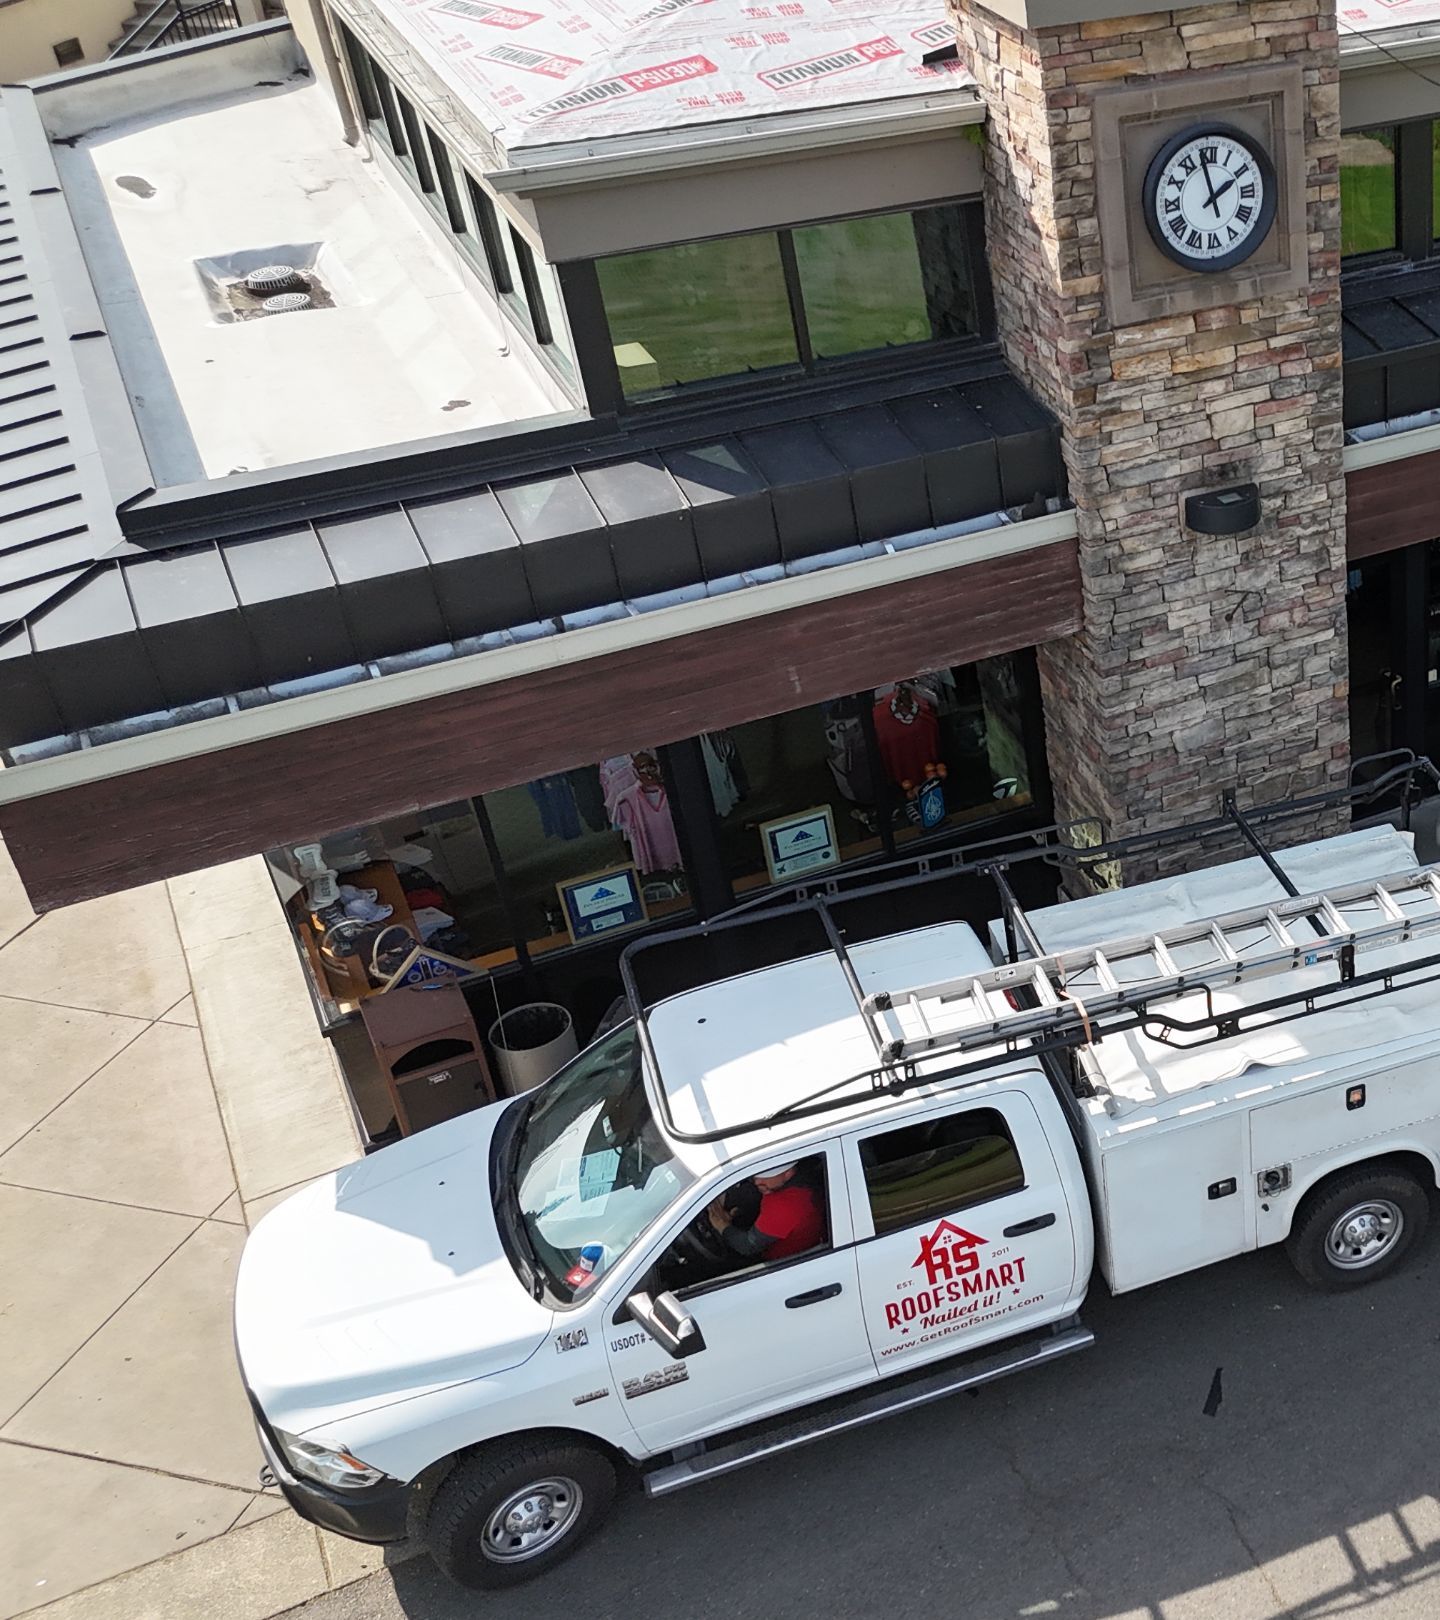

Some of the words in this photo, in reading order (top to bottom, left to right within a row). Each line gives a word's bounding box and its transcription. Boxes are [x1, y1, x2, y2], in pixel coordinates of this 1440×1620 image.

[767, 51, 861, 85] TITANIUM
[528, 81, 627, 118] TITANIUM
[632, 61, 694, 88] PSU30
[1199, 147, 1218, 165] XII
[1223, 150, 1232, 166] I
[1178, 155, 1197, 177] XI
[1234, 163, 1249, 179] II
[1168, 175, 1185, 192] X
[1240, 182, 1255, 199] III
[1164, 197, 1180, 214] IX
[1235, 204, 1253, 225] IIII
[1168, 214, 1188, 240] VIII
[1226, 226, 1239, 241] V
[1185, 229, 1202, 249] VII
[1207, 233, 1222, 249] VI
[991, 1246, 1010, 1258] 2011
[924, 1240, 980, 1286] RS
[885, 1256, 1025, 1330] ROOFSMART
[896, 1279, 915, 1290] EST.
[920, 1299, 979, 1330] Nailed
[982, 1291, 1001, 1309] it!
[881, 1293, 1044, 1357] www.GetRoofSmart.com
[611, 1333, 646, 1352] USDOT#
